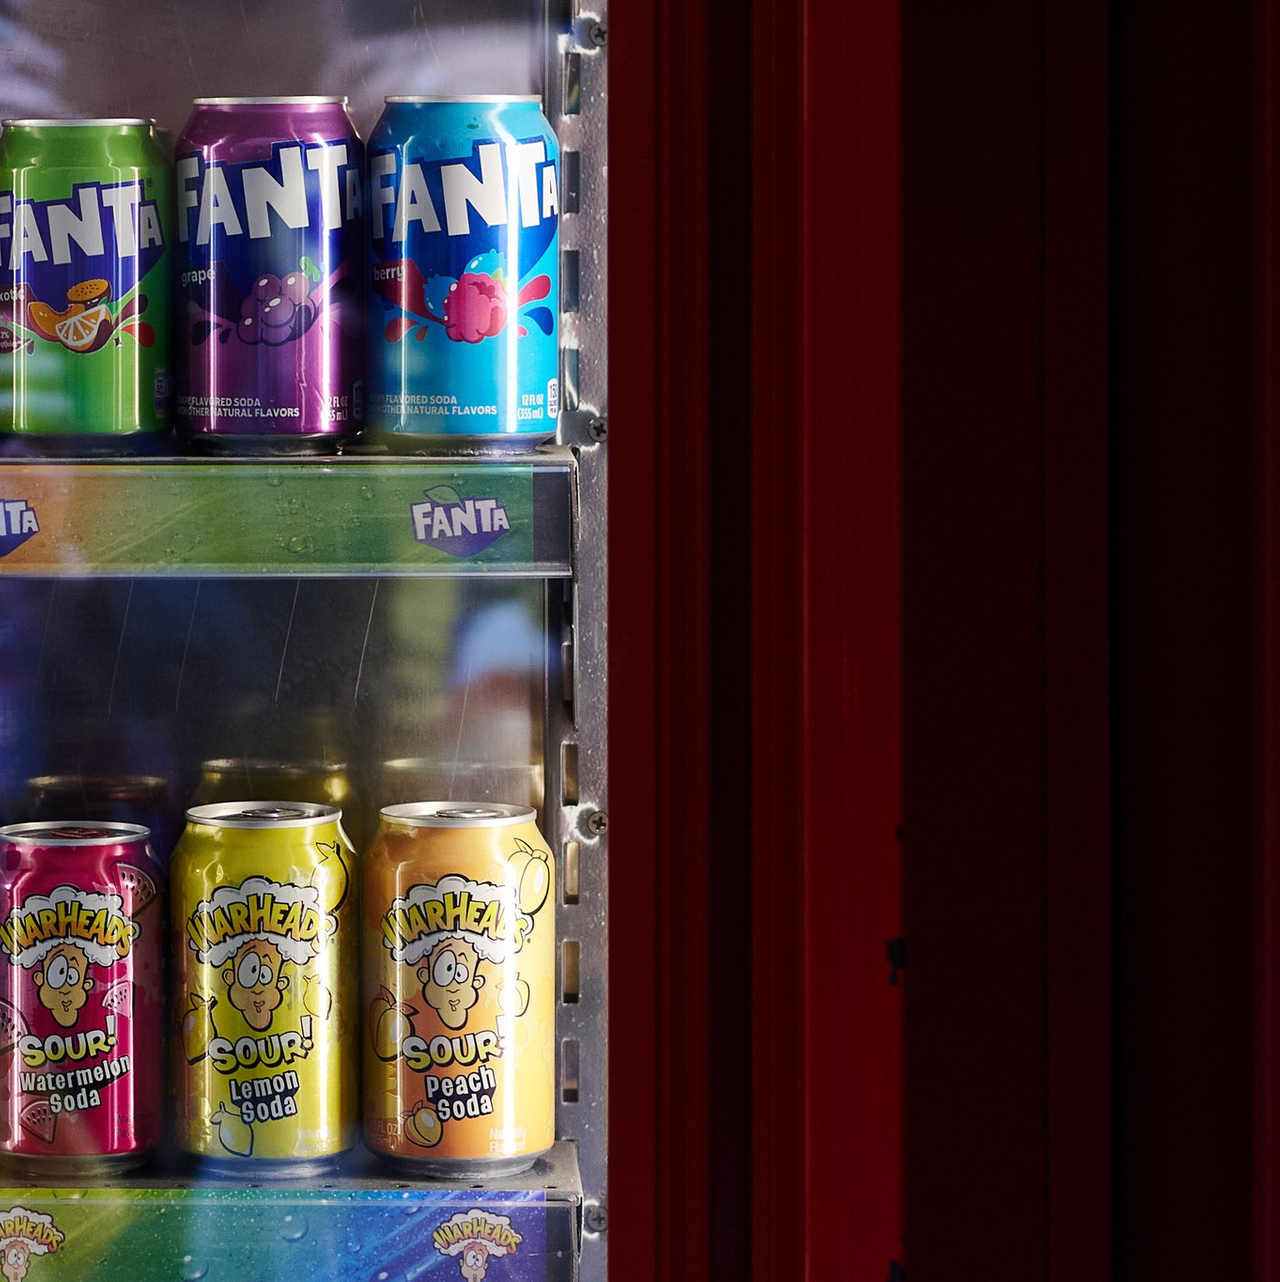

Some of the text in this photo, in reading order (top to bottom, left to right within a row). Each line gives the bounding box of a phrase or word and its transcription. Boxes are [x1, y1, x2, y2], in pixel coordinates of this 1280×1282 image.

[372, 142, 559, 243] FANTA
[180, 266, 216, 286] grape
[373, 264, 405, 285] berry
[192, 397, 232, 407] FLAVORED
[234, 398, 261, 407] SODA
[211, 408, 252, 417] NATURAL
[254, 408, 300, 417] FLAVORS
[386, 395, 457, 405] FLAVORED SODA
[407, 406, 450, 415] NATURAL
[451, 406, 497, 415] FLAVORS
[413, 503, 509, 541] FANTA
[0, 901, 136, 955] WARHEADS
[20, 1016, 116, 1067] SOUR!
[213, 1016, 313, 1071] SOUR!
[19, 1055, 130, 1092] Watermelon
[230, 1070, 299, 1099] Lemon
[426, 1066, 495, 1098] Peach
[49, 1088, 101, 1113] Soda
[242, 1095, 296, 1122] Soda
[438, 1093, 494, 1120] Soda
[433, 1217, 522, 1253] WARHEADS
